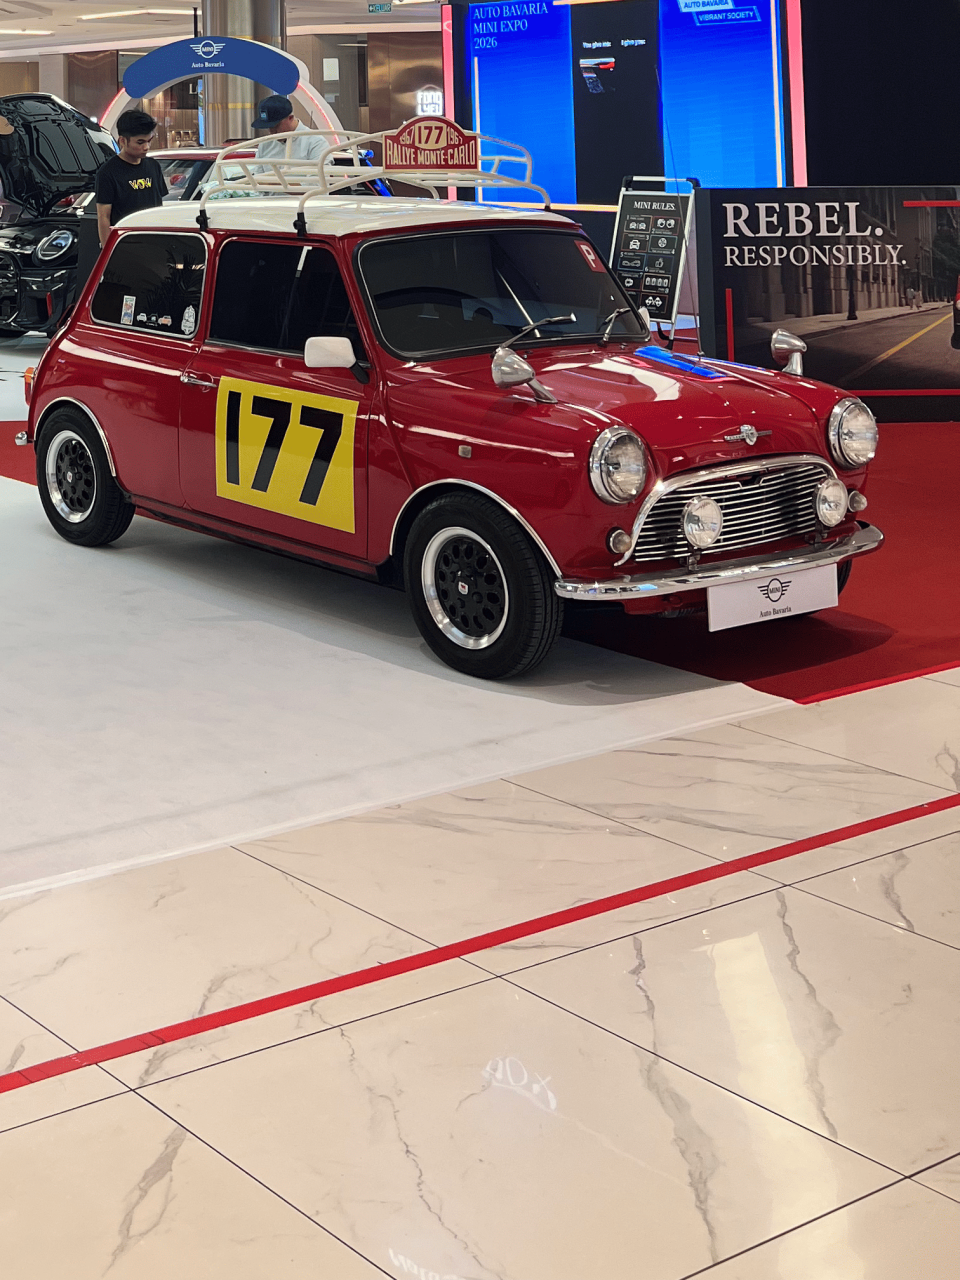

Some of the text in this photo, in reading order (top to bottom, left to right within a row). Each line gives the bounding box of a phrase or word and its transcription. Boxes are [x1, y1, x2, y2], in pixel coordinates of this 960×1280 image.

[473, 2, 549, 20] AUTO BAVARIA
[683, 0, 701, 9] AUTO
[698, 10, 754, 22] VIBRANT SOCIETY
[473, 19, 529, 35] MINI EXPO
[473, 36, 498, 50] 2026
[417, 125, 444, 145] 177
[386, 138, 476, 166] RALLYE MONTE-CARLO
[633, 201, 651, 210] MINI
[721, 202, 884, 238] REBEL.
[580, 244, 597, 268] P
[723, 244, 907, 267] RESPONSIBLY.
[226, 390, 344, 507] 177
[769, 586, 781, 594] MINI
[759, 605, 792, 618] Auto Bavaria
